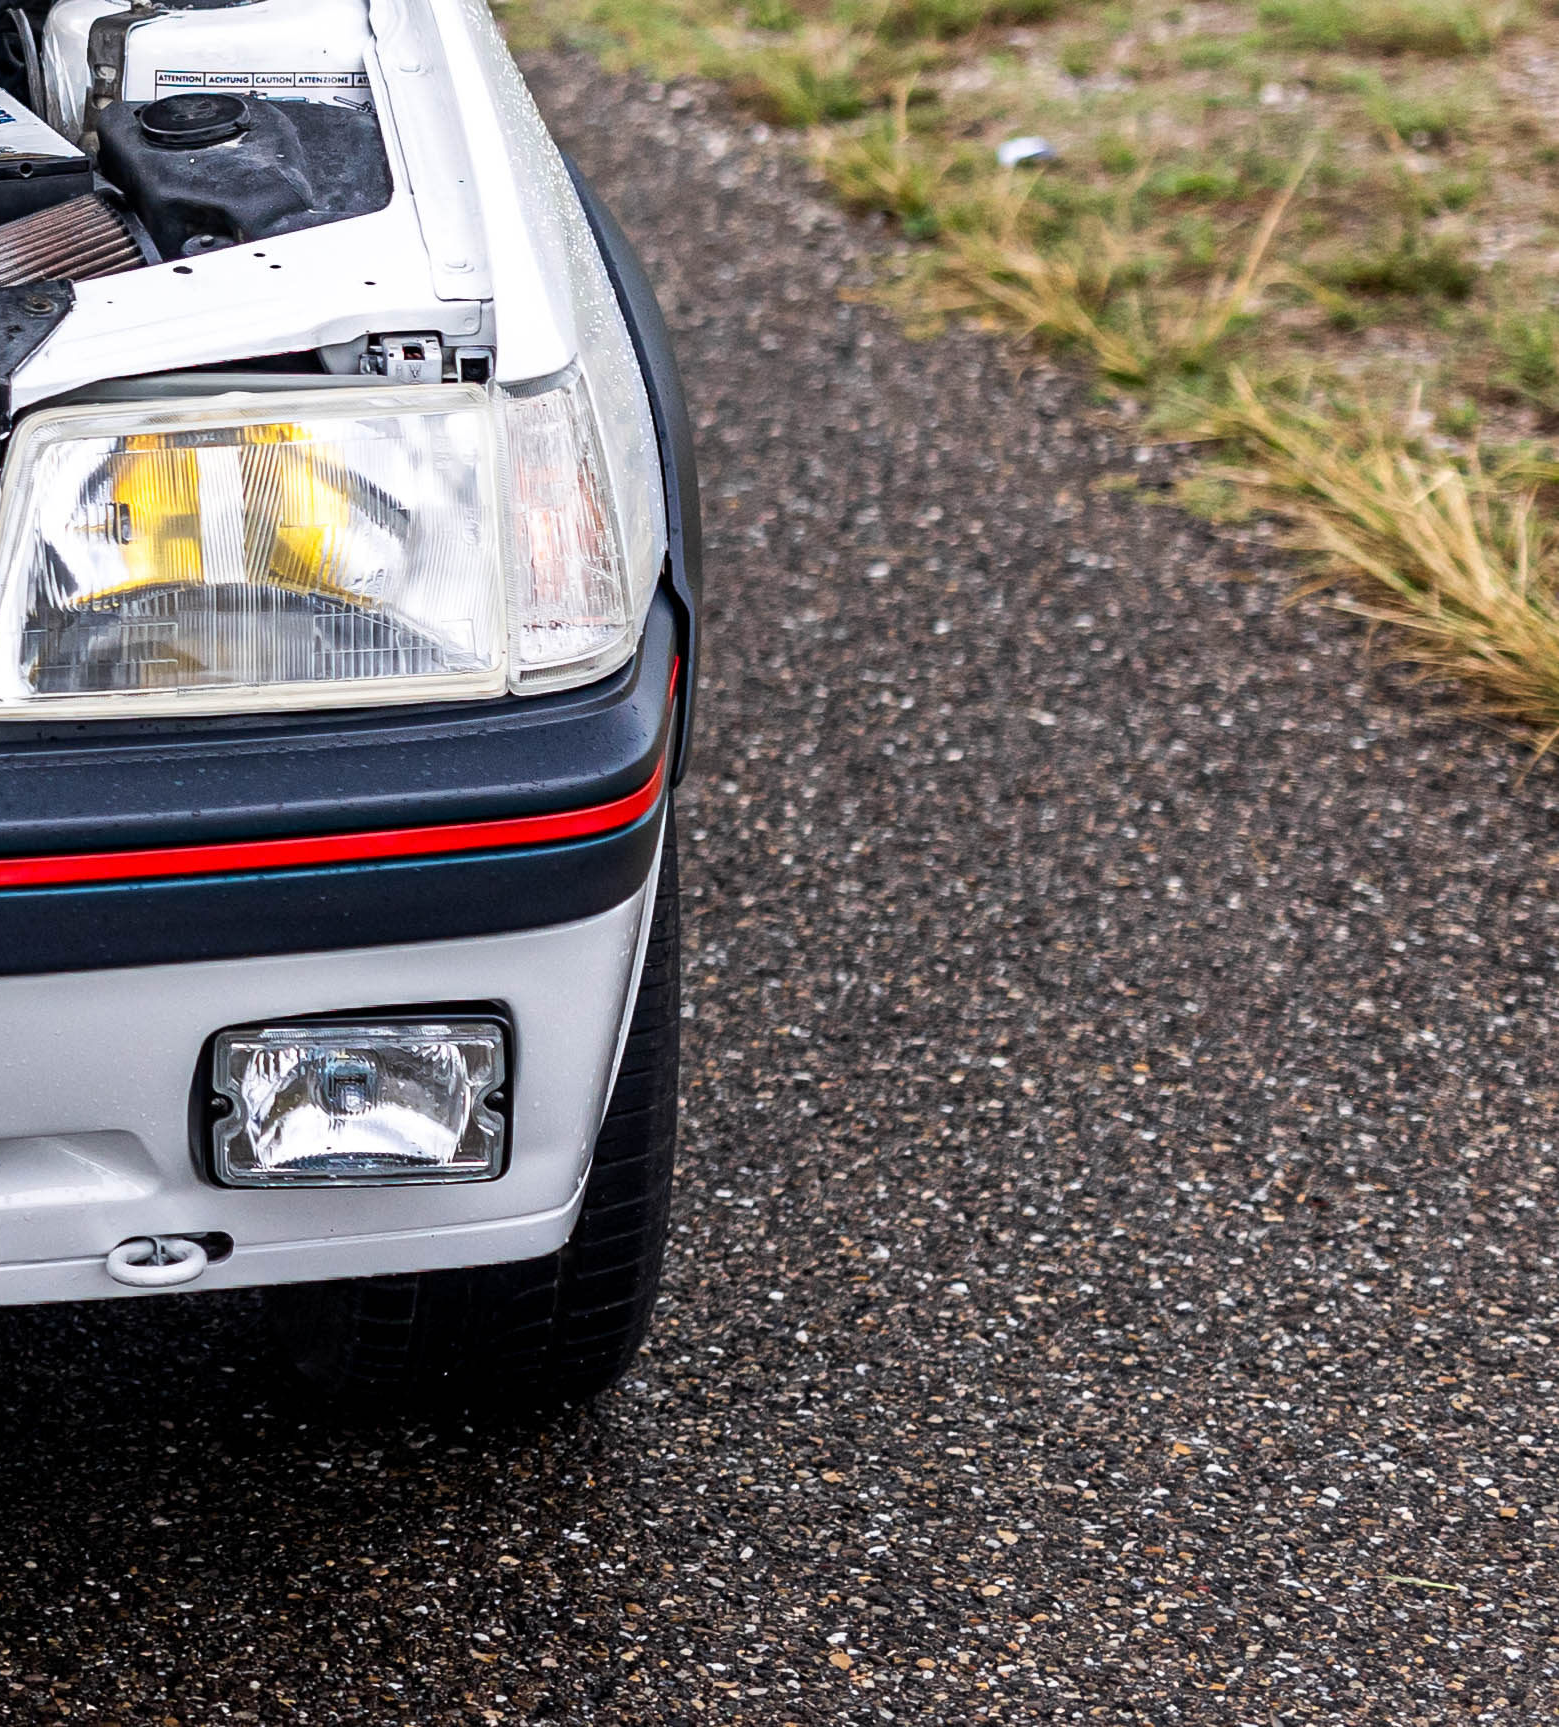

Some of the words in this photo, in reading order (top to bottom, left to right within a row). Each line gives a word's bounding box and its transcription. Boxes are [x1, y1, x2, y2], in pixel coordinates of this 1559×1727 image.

[158, 74, 201, 83] ATTENTION
[208, 76, 249, 84] ACHTUNG
[255, 76, 292, 84] CAUTION
[298, 76, 348, 84] ATTENZIONE
